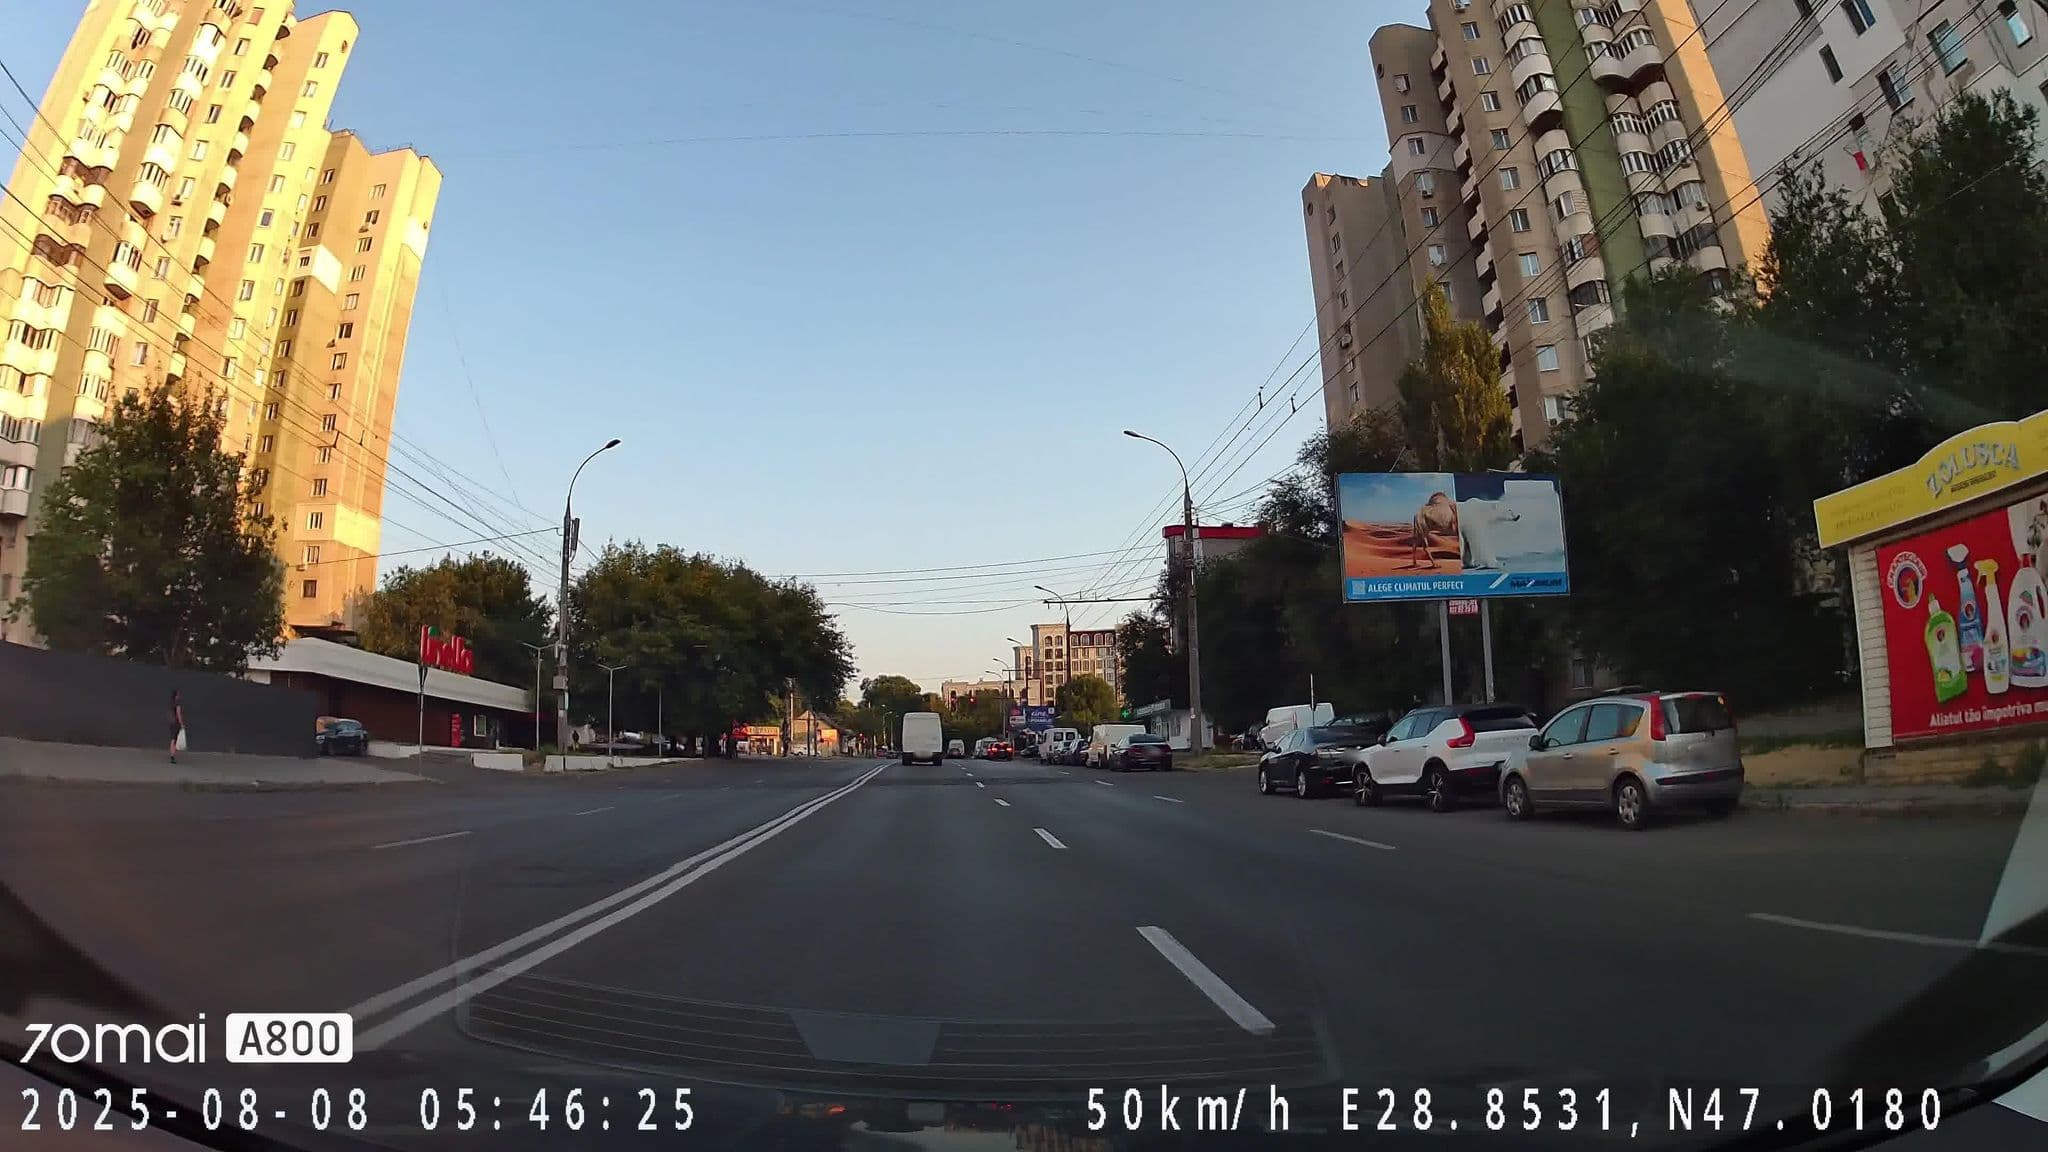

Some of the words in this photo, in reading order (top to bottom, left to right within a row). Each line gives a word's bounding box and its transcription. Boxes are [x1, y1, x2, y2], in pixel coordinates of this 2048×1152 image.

[1368, 583, 1392, 593] ALEGE
[1394, 581, 1431, 592] CLIMATUL
[1433, 580, 1464, 591] PERFECT
[1929, 711, 1963, 727] Aliatul
